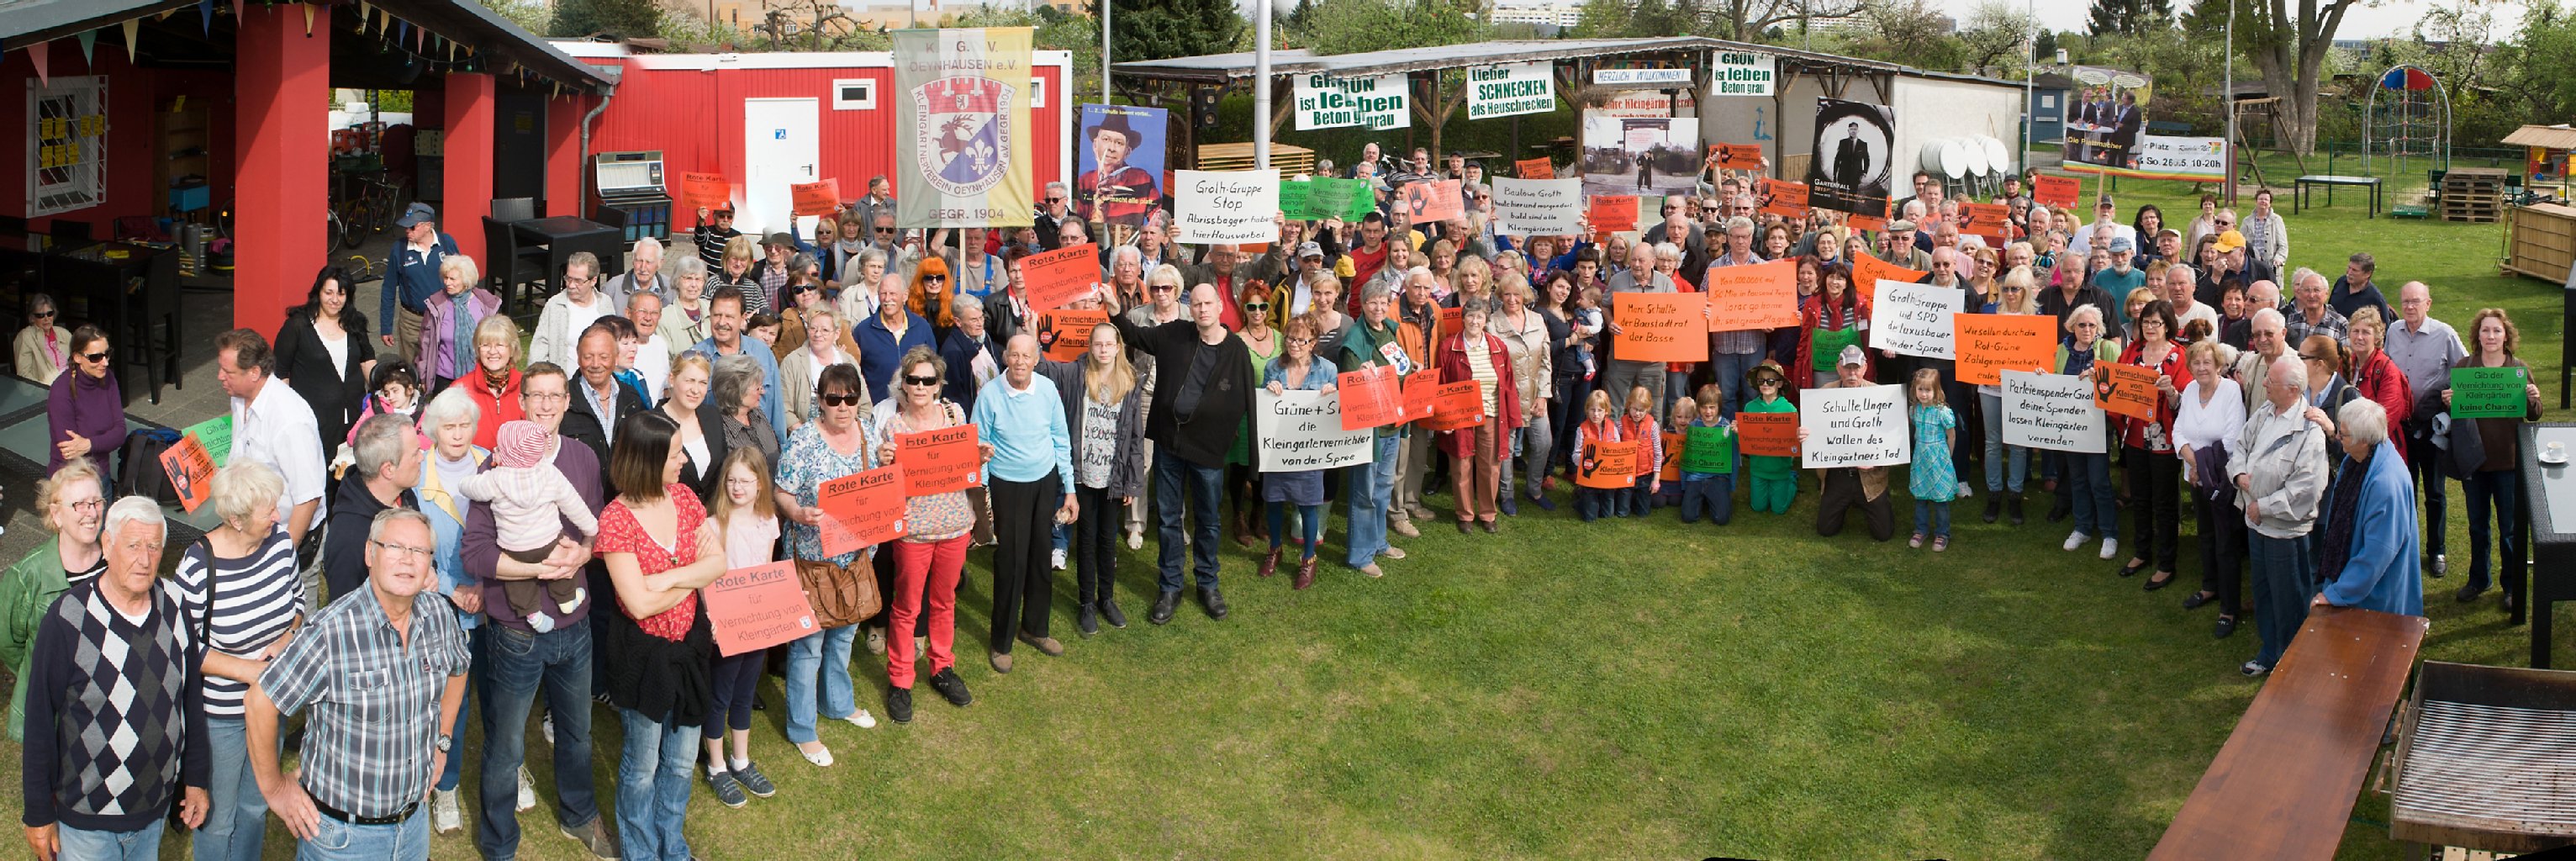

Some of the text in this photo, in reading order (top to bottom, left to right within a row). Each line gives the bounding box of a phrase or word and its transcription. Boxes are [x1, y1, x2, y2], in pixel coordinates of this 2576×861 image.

[926, 40, 998, 52] K. G. V.
[1722, 53, 1755, 65] GRÜN
[910, 60, 1016, 71] OEYNHAUSEN e.V.
[1472, 68, 1510, 82] Lieber
[1598, 71, 1629, 82] HERZLICH
[1715, 67, 1771, 82] ist leben
[1479, 80, 1546, 100] SCHNECKEN
[1722, 82, 1765, 94] Beton grau
[1300, 98, 1316, 110] ist
[1471, 98, 1552, 116] als Heuschrecken
[1313, 112, 1350, 125] Beton
[915, 90, 952, 192] KLEINGÄRTNERVEREIN
[954, 161, 1006, 194] OEYNHAUSEN
[2081, 139, 2122, 150] Plattmacher
[2146, 157, 2161, 166] So.
[1196, 180, 1262, 197] Groth-Gruppe
[1775, 184, 1807, 194] Vernichtung
[1814, 178, 1850, 189] GARTENFALL
[1314, 188, 1349, 198] Vernichtung
[1538, 189, 1562, 198] Groth
[1212, 197, 1243, 212] Stop
[929, 209, 1004, 219] GEGR. 1904
[1187, 214, 1248, 226] Abrissbagger
[1508, 224, 1550, 233] Kleingärten
[1029, 249, 1088, 267] Rote Karte
[1865, 262, 1886, 278] Groth
[1032, 276, 1078, 294] Vernichtung
[1043, 286, 1088, 303] Kleingärten
[1628, 304, 1676, 314] Marc Schulte
[1750, 304, 1759, 312] go
[1620, 317, 1633, 326] der
[1917, 312, 1938, 323] SPD
[1629, 332, 1643, 341] der
[1963, 325, 2036, 336] Wir sollen durch die
[1898, 341, 1944, 355] der Spree
[1975, 339, 2020, 351] Rot-Grüne
[1964, 352, 2040, 367] Zählgemeinschaft
[2115, 368, 2156, 383] Vernichtung
[2009, 378, 2093, 400] Parteienspender Grot
[2457, 382, 2504, 390] Vernichtung
[2116, 389, 2155, 404] Kleingärten
[1275, 400, 1312, 415] Grüne
[1823, 398, 1892, 415] Schulte, Unger
[2019, 399, 2086, 416] deine Spenden
[1298, 421, 1317, 431] die
[1830, 416, 1882, 429] und Groth
[2035, 416, 2088, 432] Kleingärten
[206, 426, 219, 435] Gib
[932, 430, 968, 443] Karte
[1827, 434, 1883, 445] wollen des
[2028, 433, 2074, 446] verenden
[1751, 444, 1788, 452] Kleingärten
[1885, 448, 1900, 459] Tod
[926, 452, 940, 461] für
[1282, 452, 1355, 466] von der Spree
[956, 460, 974, 469] von
[1600, 465, 1634, 475] Kleingärten
[828, 471, 895, 494] Rote Karte
[855, 495, 868, 506] für
[826, 506, 900, 531] Vernichtung von
[715, 568, 786, 589] Rote Karte
[748, 593, 763, 605] für
[719, 603, 802, 629] Vernichtung von
[737, 621, 797, 642] Kleingärten
